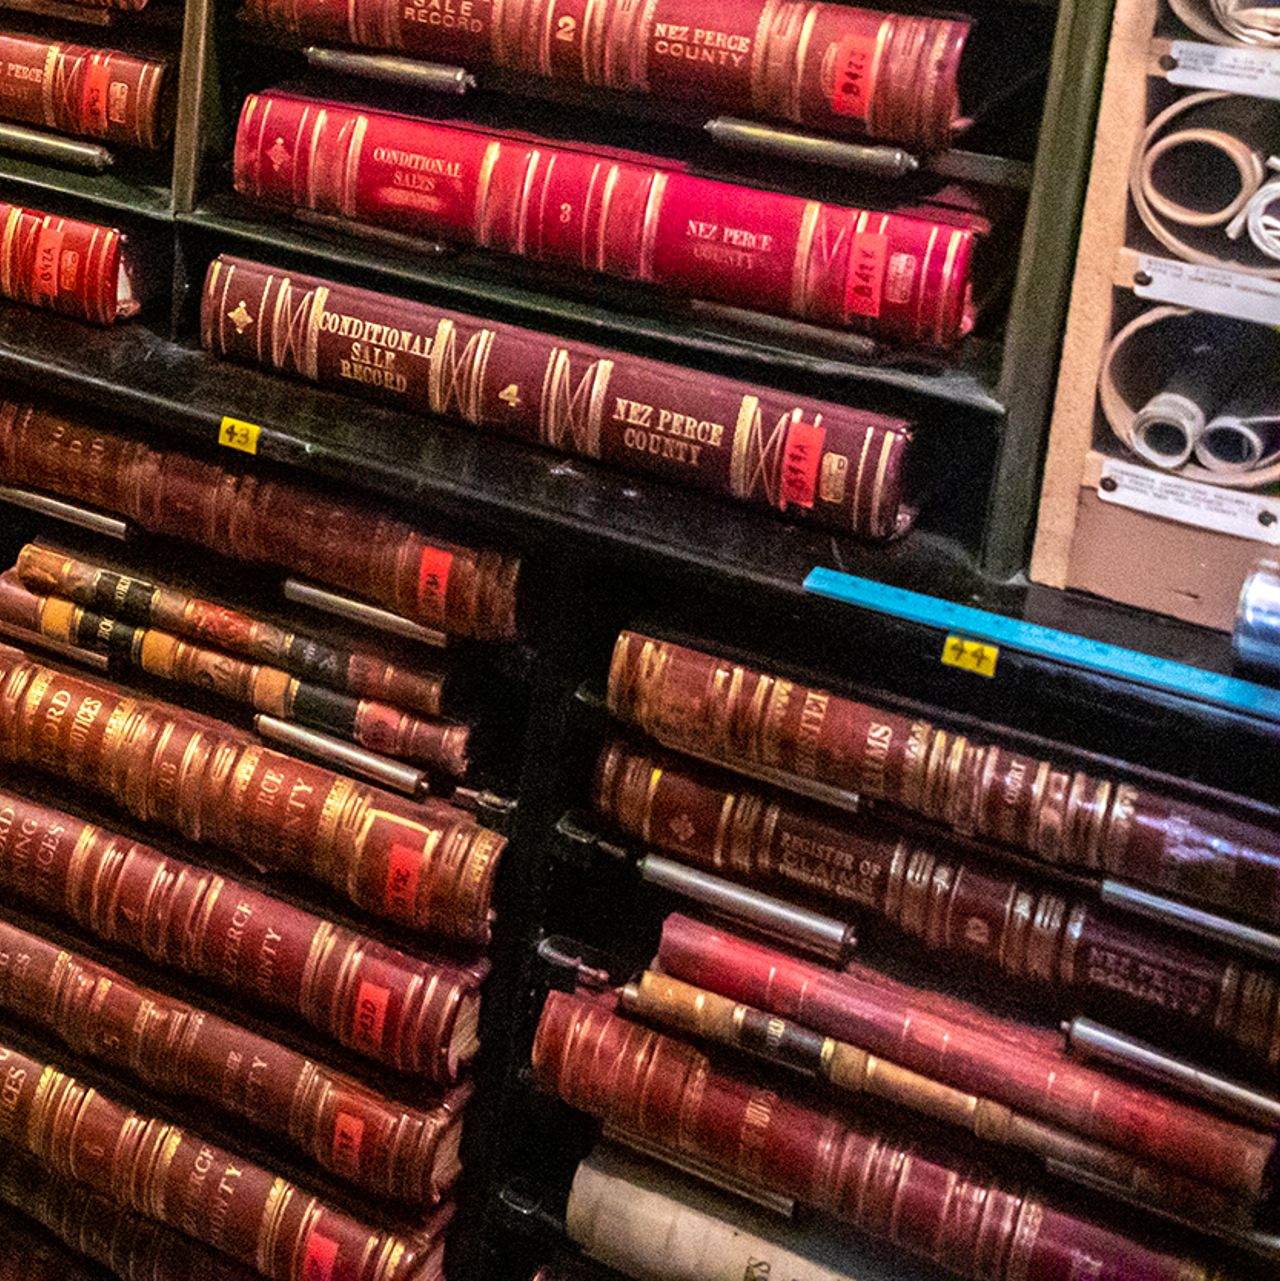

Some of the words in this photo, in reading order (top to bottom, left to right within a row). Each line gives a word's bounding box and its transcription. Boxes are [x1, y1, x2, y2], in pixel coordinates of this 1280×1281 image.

[404, 9, 484, 34] RECORD
[557, 15, 576, 42] 2
[655, 23, 694, 44] NEZ
[696, 27, 750, 53] PERCE
[655, 42, 745, 67] COUNTY
[7, 62, 44, 83] PERCE
[373, 147, 463, 179] CONDITIONAL
[558, 202, 574, 224] 3
[686, 220, 718, 240] NEZ
[722, 226, 773, 253] PERCE
[319, 311, 435, 358] CONDITIONAL
[350, 343, 397, 369] SALE
[339, 358, 408, 394] RECORD
[498, 383, 522, 407] 4
[612, 397, 656, 424] NEZ
[658, 409, 724, 446] PERCE
[225, 425, 252, 445] 43
[623, 425, 703, 466] COUNTY
[949, 642, 989, 667] 44
